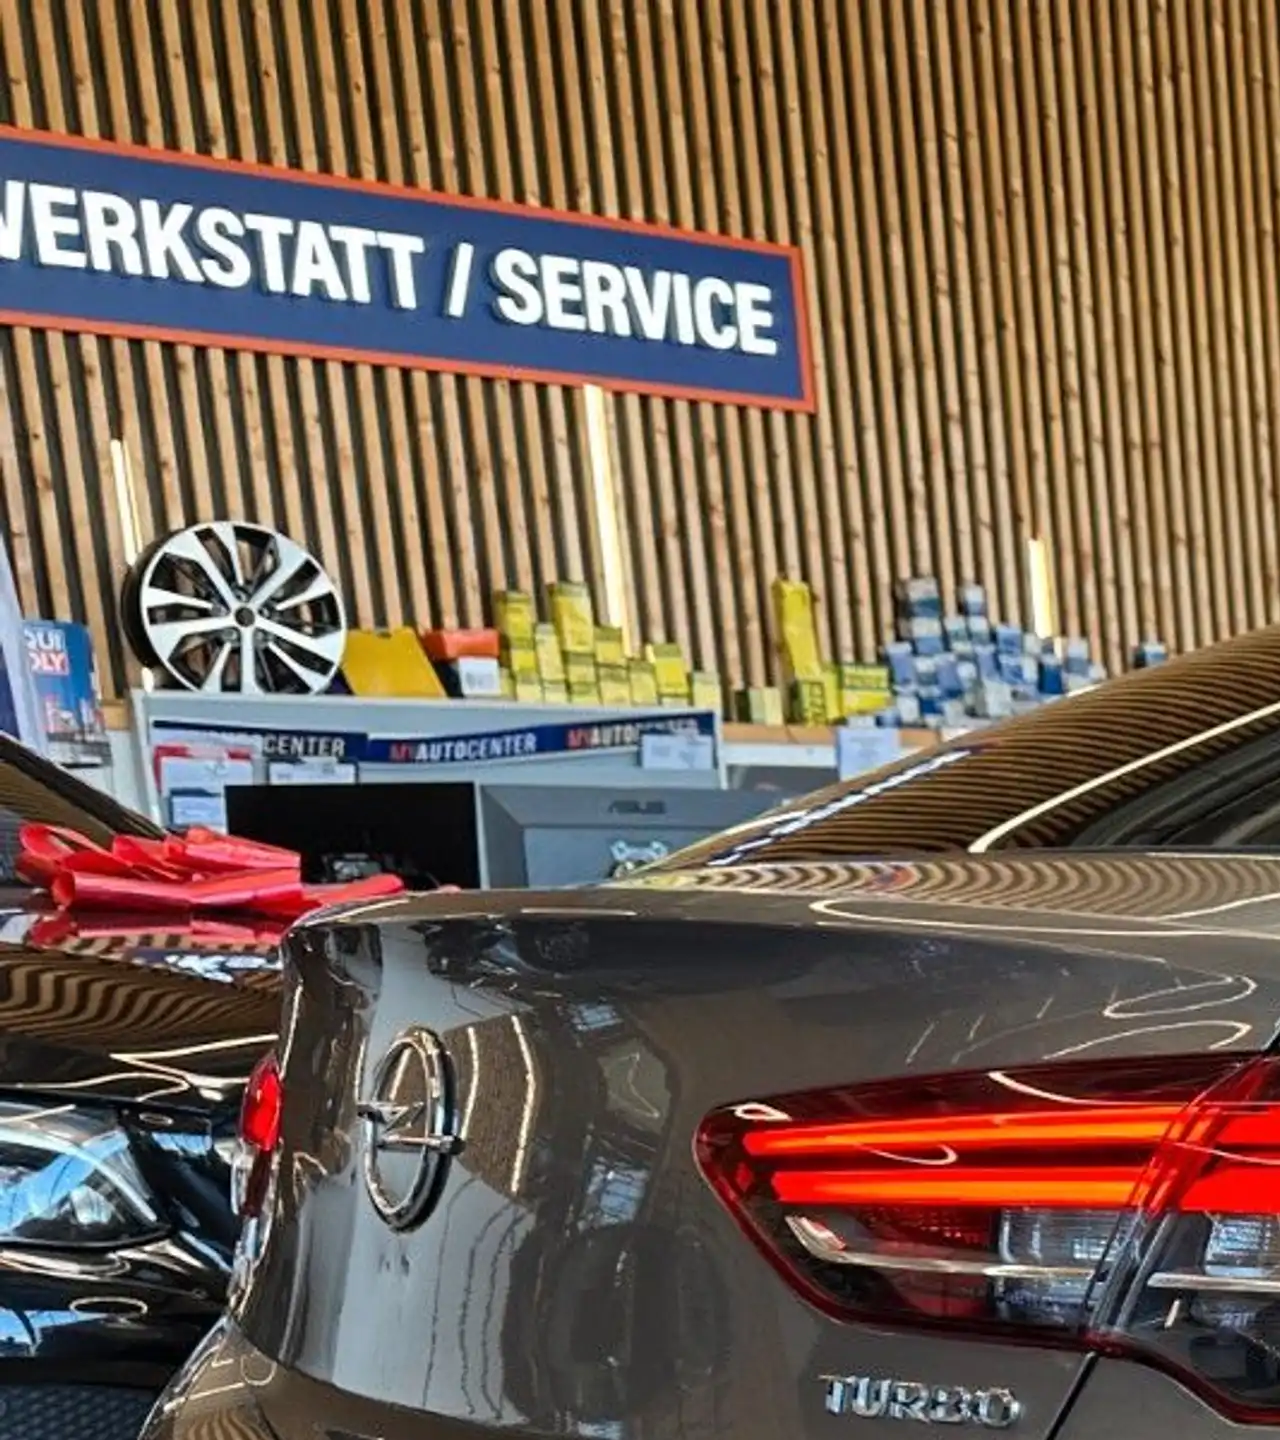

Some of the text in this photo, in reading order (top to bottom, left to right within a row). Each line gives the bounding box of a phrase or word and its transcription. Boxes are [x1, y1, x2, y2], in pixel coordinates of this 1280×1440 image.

[448, 242, 474, 318] /
[494, 247, 777, 356] SERVICE
[389, 732, 537, 763] MYAUTOCENTER
[818, 1374, 1022, 1429] TURBO
